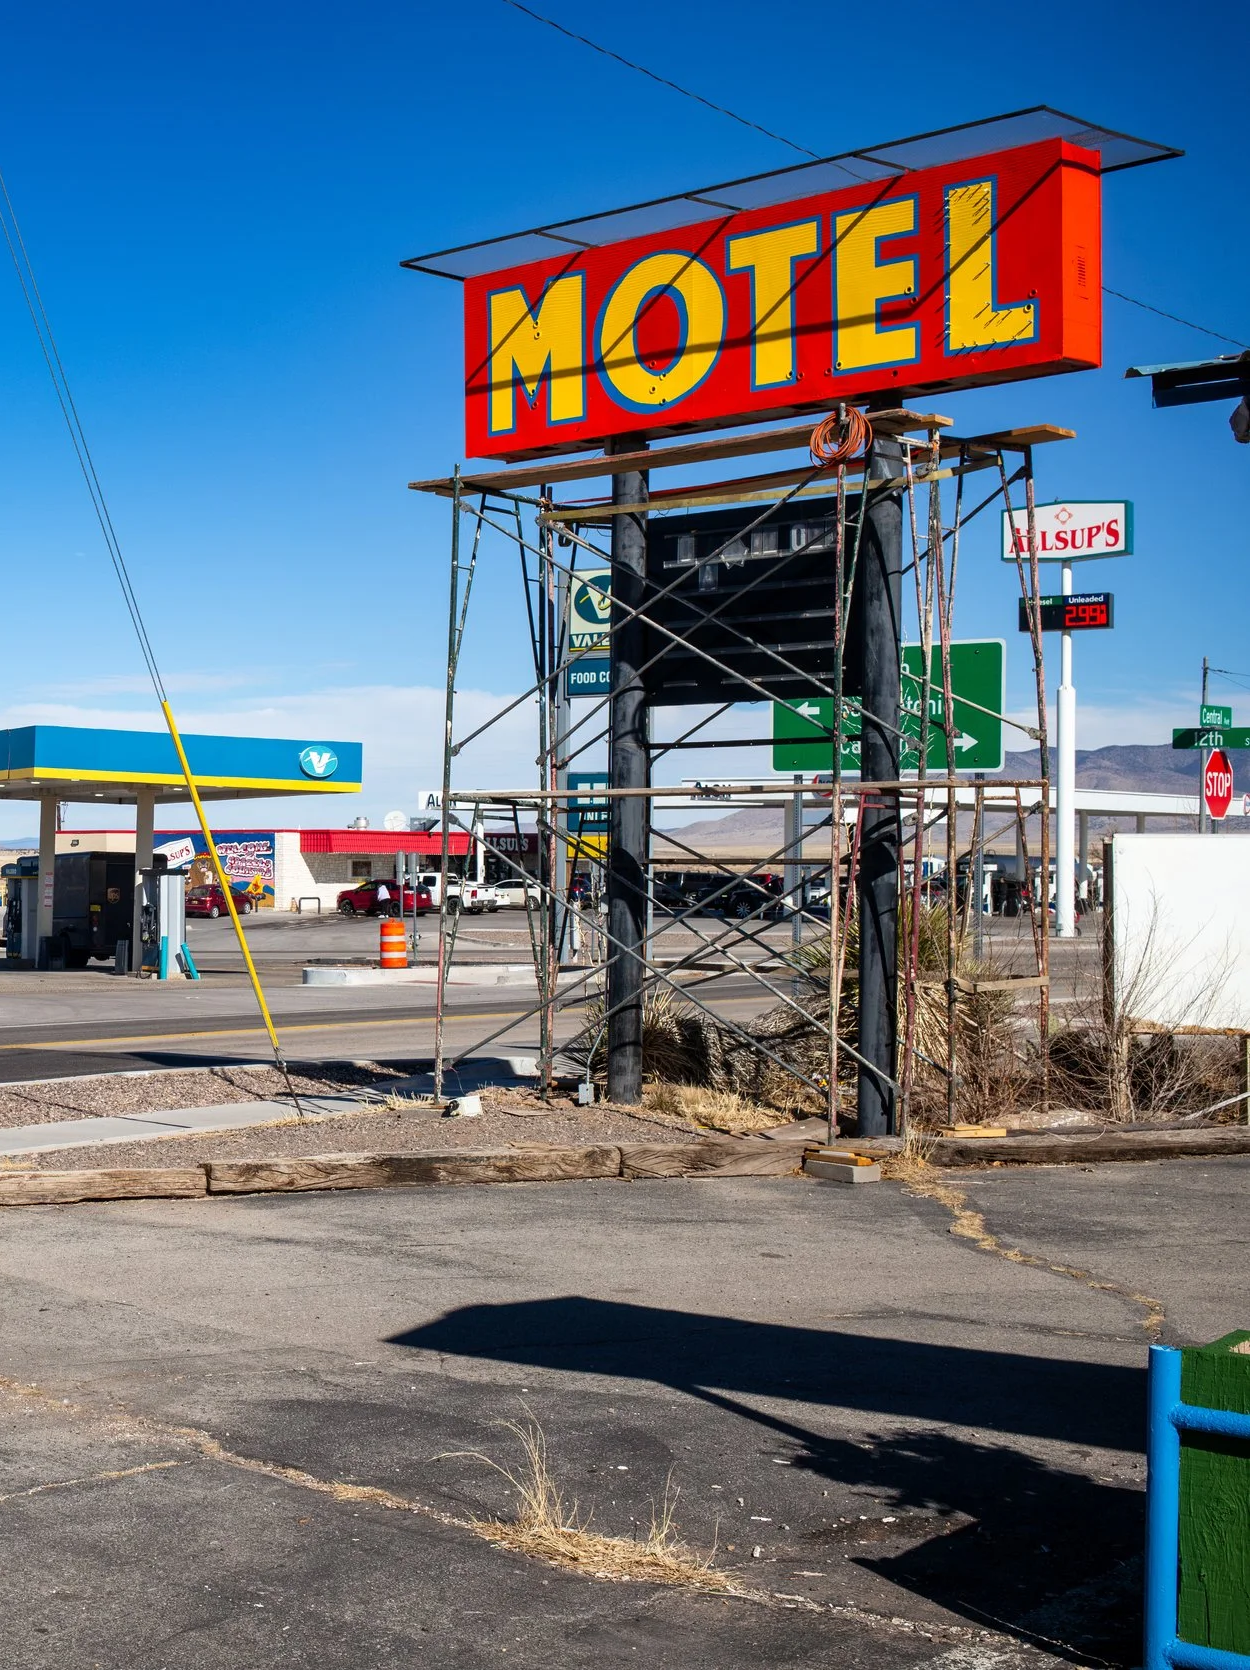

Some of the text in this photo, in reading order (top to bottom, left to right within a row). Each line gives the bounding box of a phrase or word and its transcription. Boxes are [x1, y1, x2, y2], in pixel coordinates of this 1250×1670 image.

[489, 176, 1039, 437] MOTEL
[1009, 519, 1120, 553] ALLSUP'S
[1069, 595, 1104, 604] Unleaded
[572, 633, 610, 647] VALE
[570, 672, 596, 684] FOOD
[1202, 707, 1223, 725] Central
[1194, 731, 1223, 746] 12th
[1206, 772, 1231, 797] STOP
[427, 793, 456, 807] ALN
[217, 842, 271, 854] WELCOME
